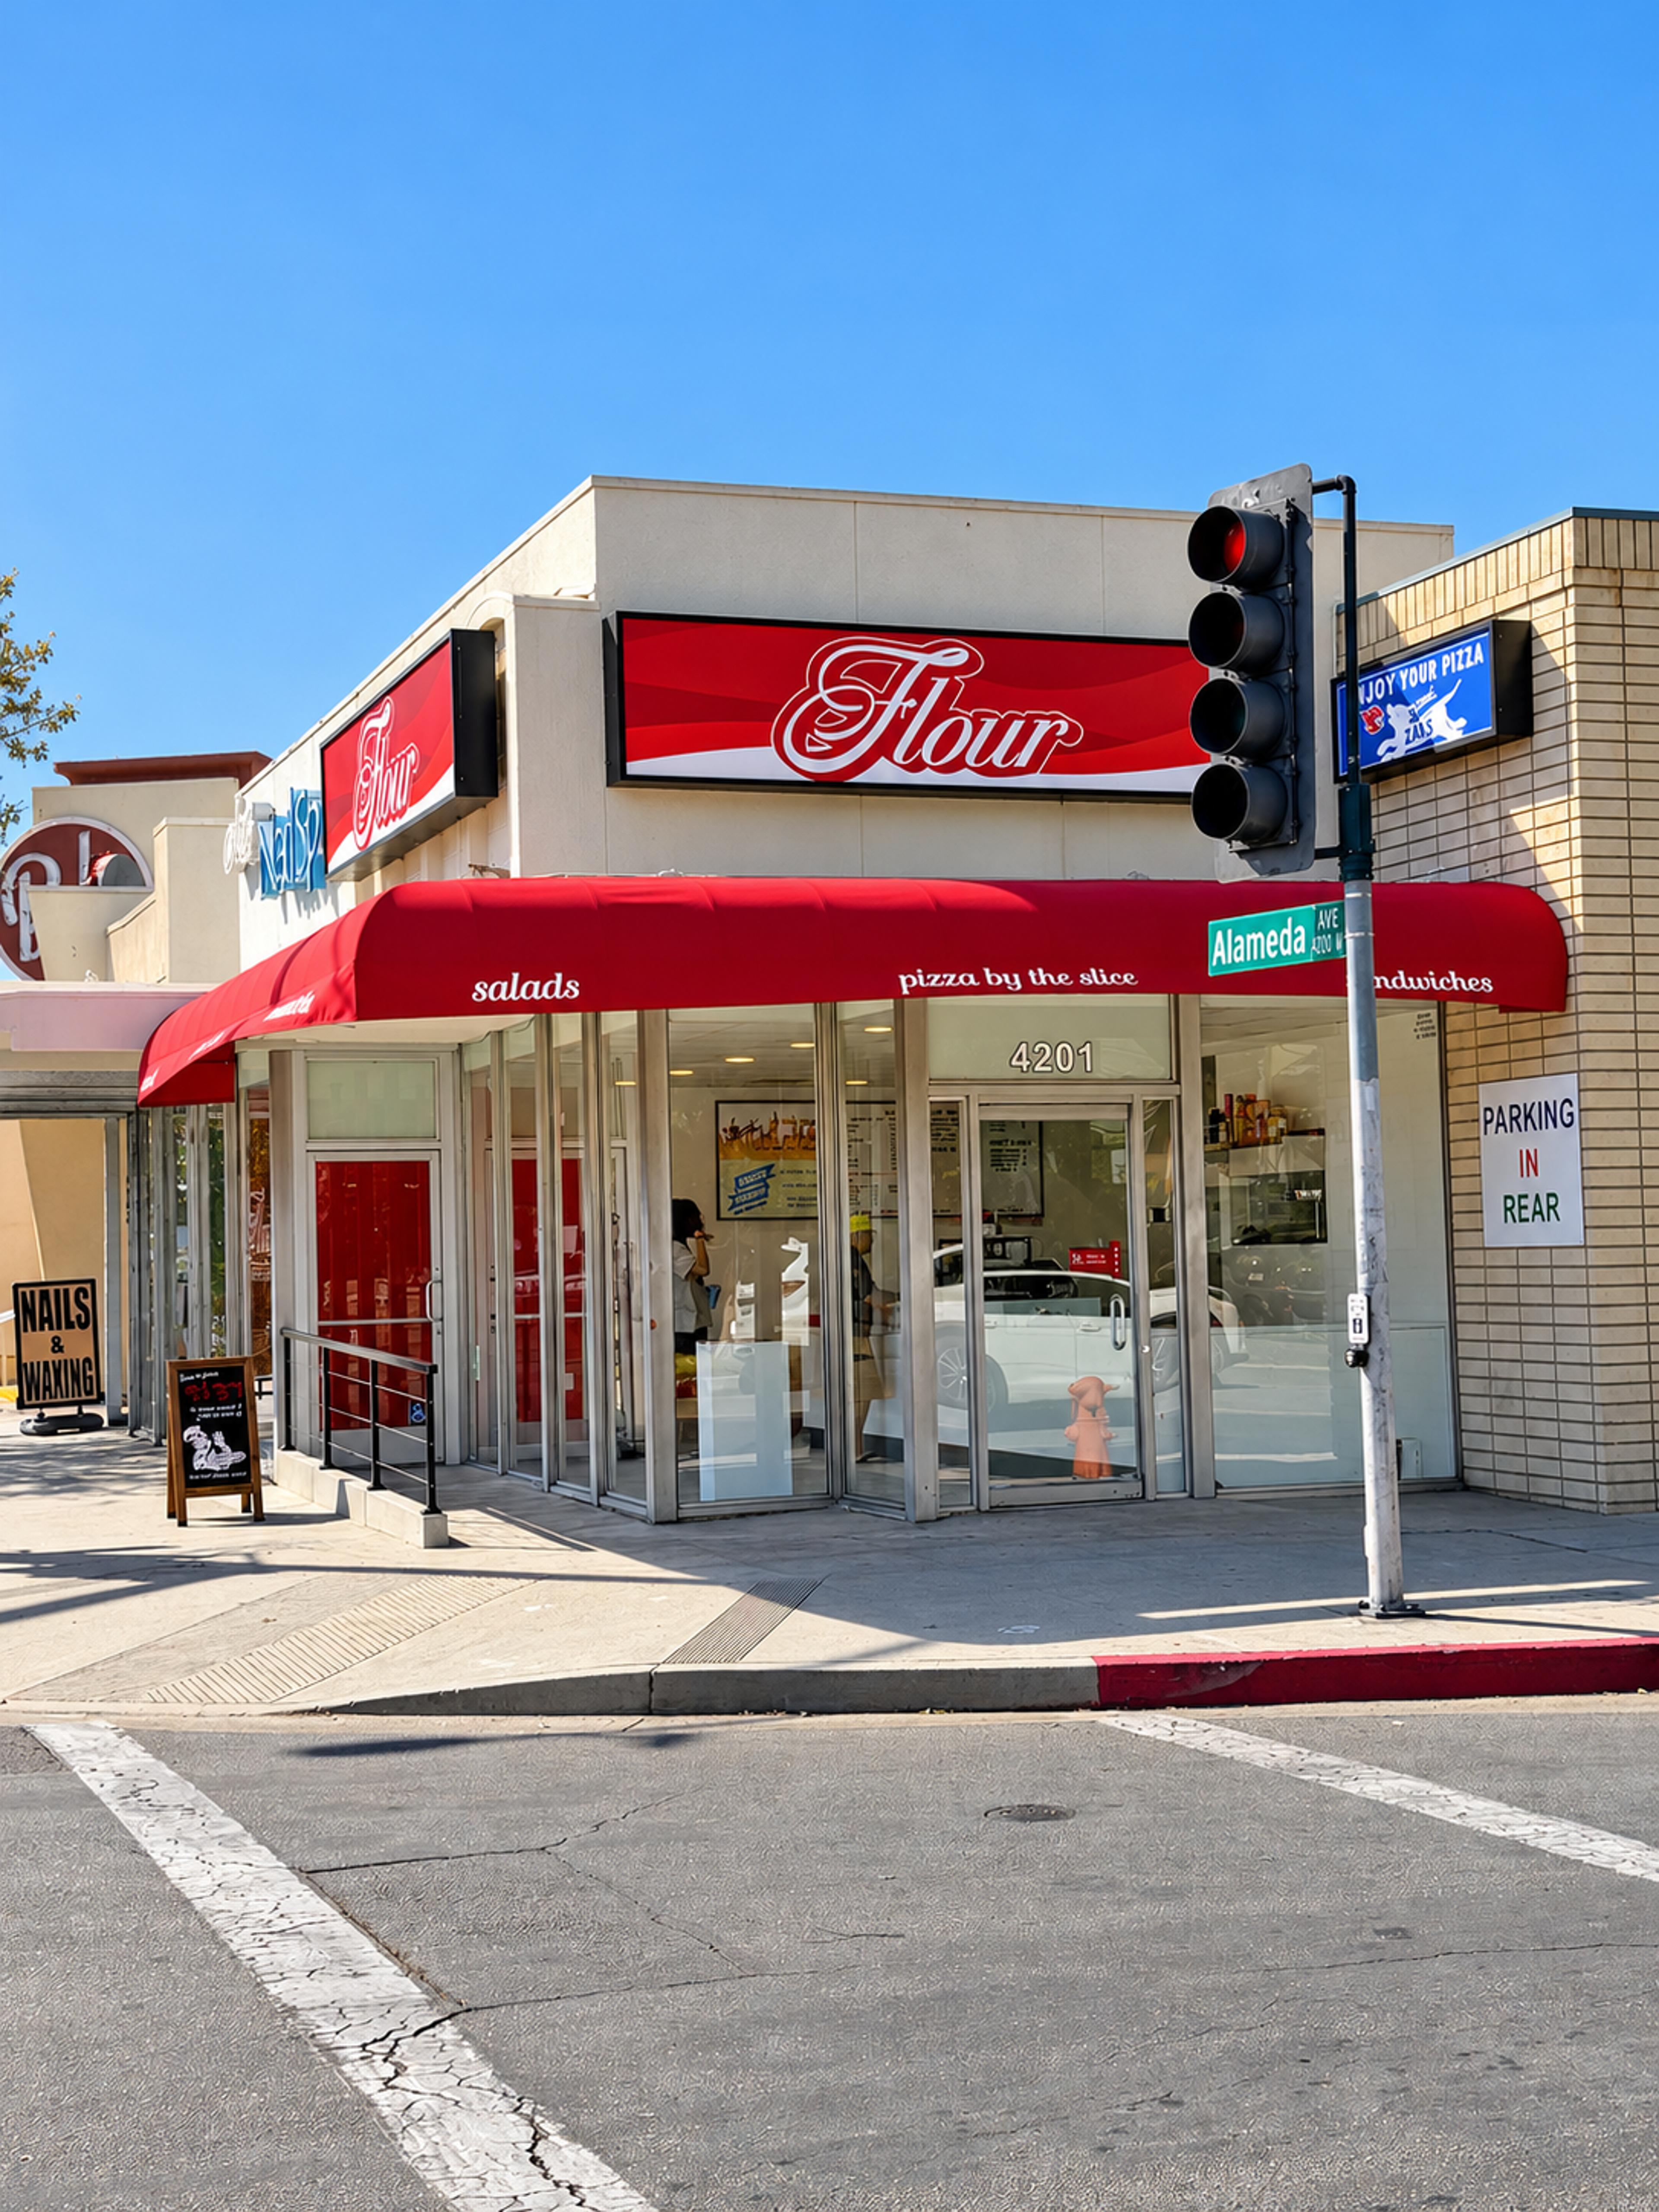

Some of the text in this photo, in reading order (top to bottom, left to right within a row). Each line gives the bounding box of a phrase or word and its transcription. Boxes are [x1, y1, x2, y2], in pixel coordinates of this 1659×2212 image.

[1359, 673, 1395, 704] NJOY
[1399, 660, 1437, 690] YOUR
[1442, 642, 1484, 676] PIZZA
[780, 642, 1070, 774] Flour
[1318, 907, 1339, 930] AVE
[1212, 916, 1306, 966] Alameda
[471, 972, 580, 1002] salads
[898, 967, 1138, 995] pizza by the slice
[1373, 969, 1493, 992] ndwiches
[1009, 1040, 1093, 1073] 4201
[1483, 1097, 1574, 1135] PARKING
[1519, 1148, 1539, 1178] IN
[1503, 1192, 1560, 1224] REAR
[21, 1287, 91, 1332] NAILS
[51, 1335, 65, 1354] &
[22, 1357, 94, 1402] WAXING
